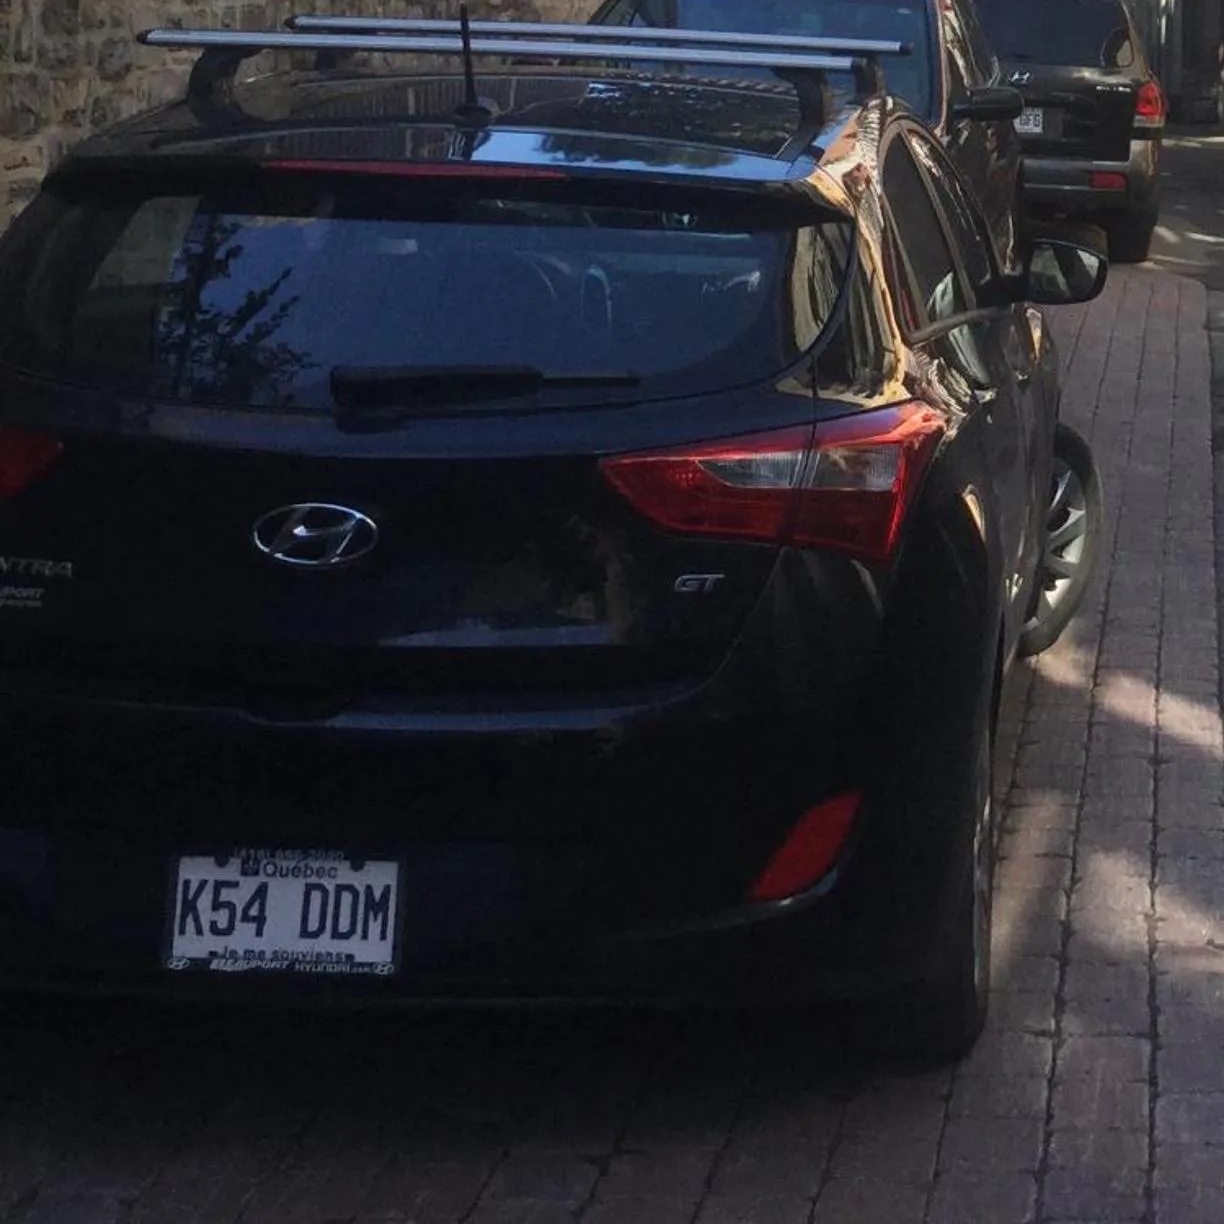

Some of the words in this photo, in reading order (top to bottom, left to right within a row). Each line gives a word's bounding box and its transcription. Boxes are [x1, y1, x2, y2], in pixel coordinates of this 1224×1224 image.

[673, 573, 727, 594] GT
[262, 860, 339, 880] Québec
[177, 878, 270, 939] K54
[298, 881, 392, 942] DDM
